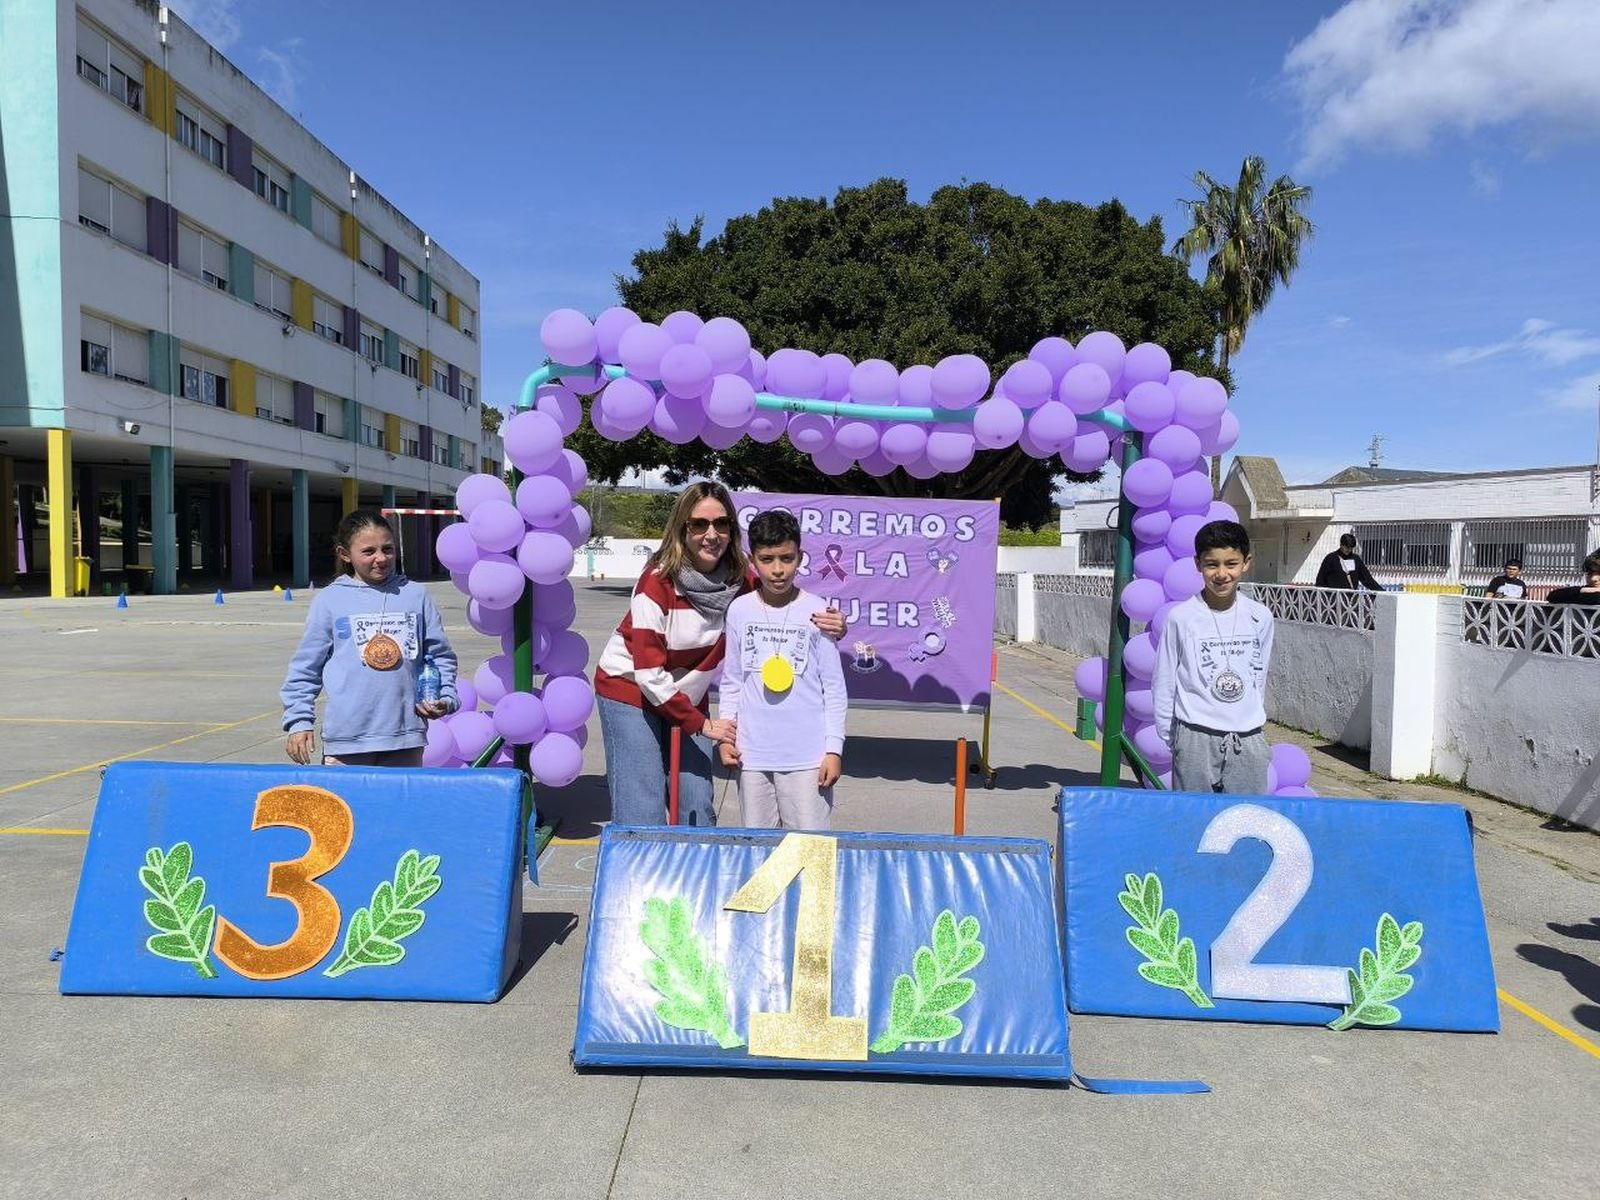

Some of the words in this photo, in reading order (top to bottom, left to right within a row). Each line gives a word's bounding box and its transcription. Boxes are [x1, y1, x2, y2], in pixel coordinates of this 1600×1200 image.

[737, 505, 976, 542] CRREMOS
[855, 550, 909, 578] LA
[822, 597, 920, 628] JER
[213, 784, 354, 980] 3
[1197, 803, 1354, 1005] 2
[723, 833, 868, 1061] 1
